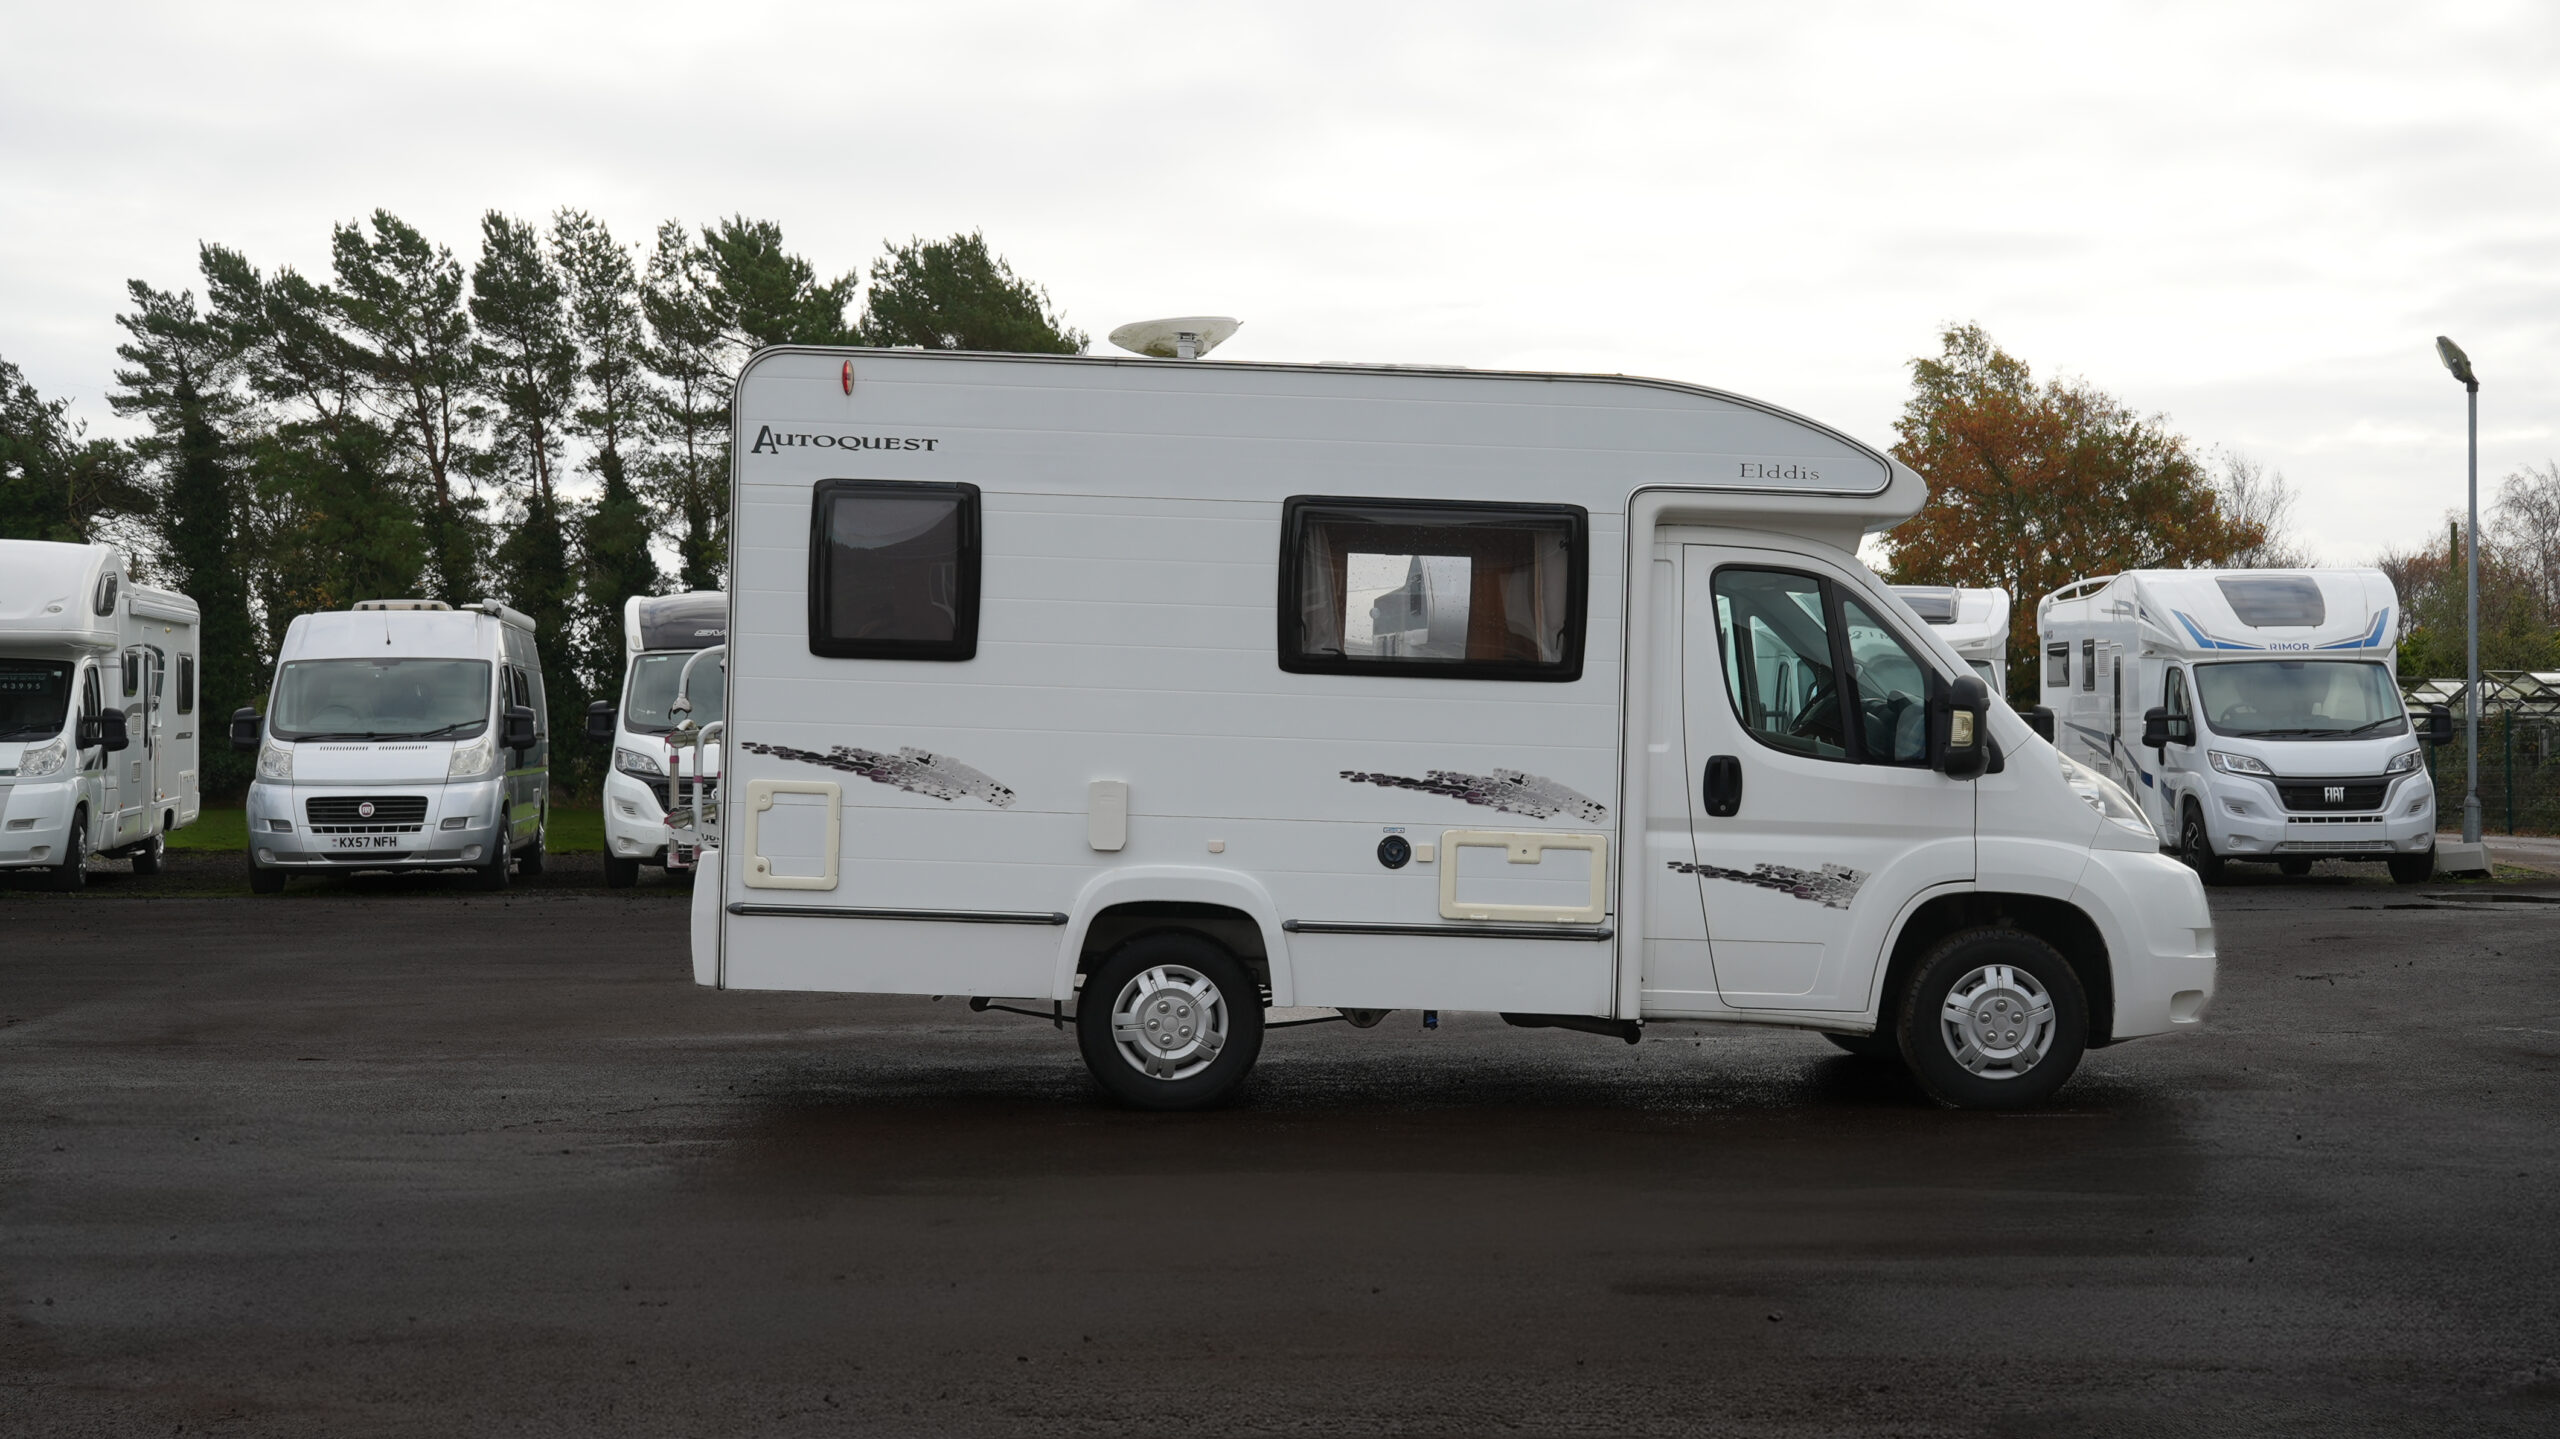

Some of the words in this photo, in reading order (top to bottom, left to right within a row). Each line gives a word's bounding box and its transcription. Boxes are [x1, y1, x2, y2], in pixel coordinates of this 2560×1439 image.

[1739, 463, 1820, 480] Elddis
[2269, 643, 2310, 651] RIMOR
[2324, 786, 2345, 803] FIAT
[339, 837, 371, 848] KX57
[373, 836, 397, 848] NFH
